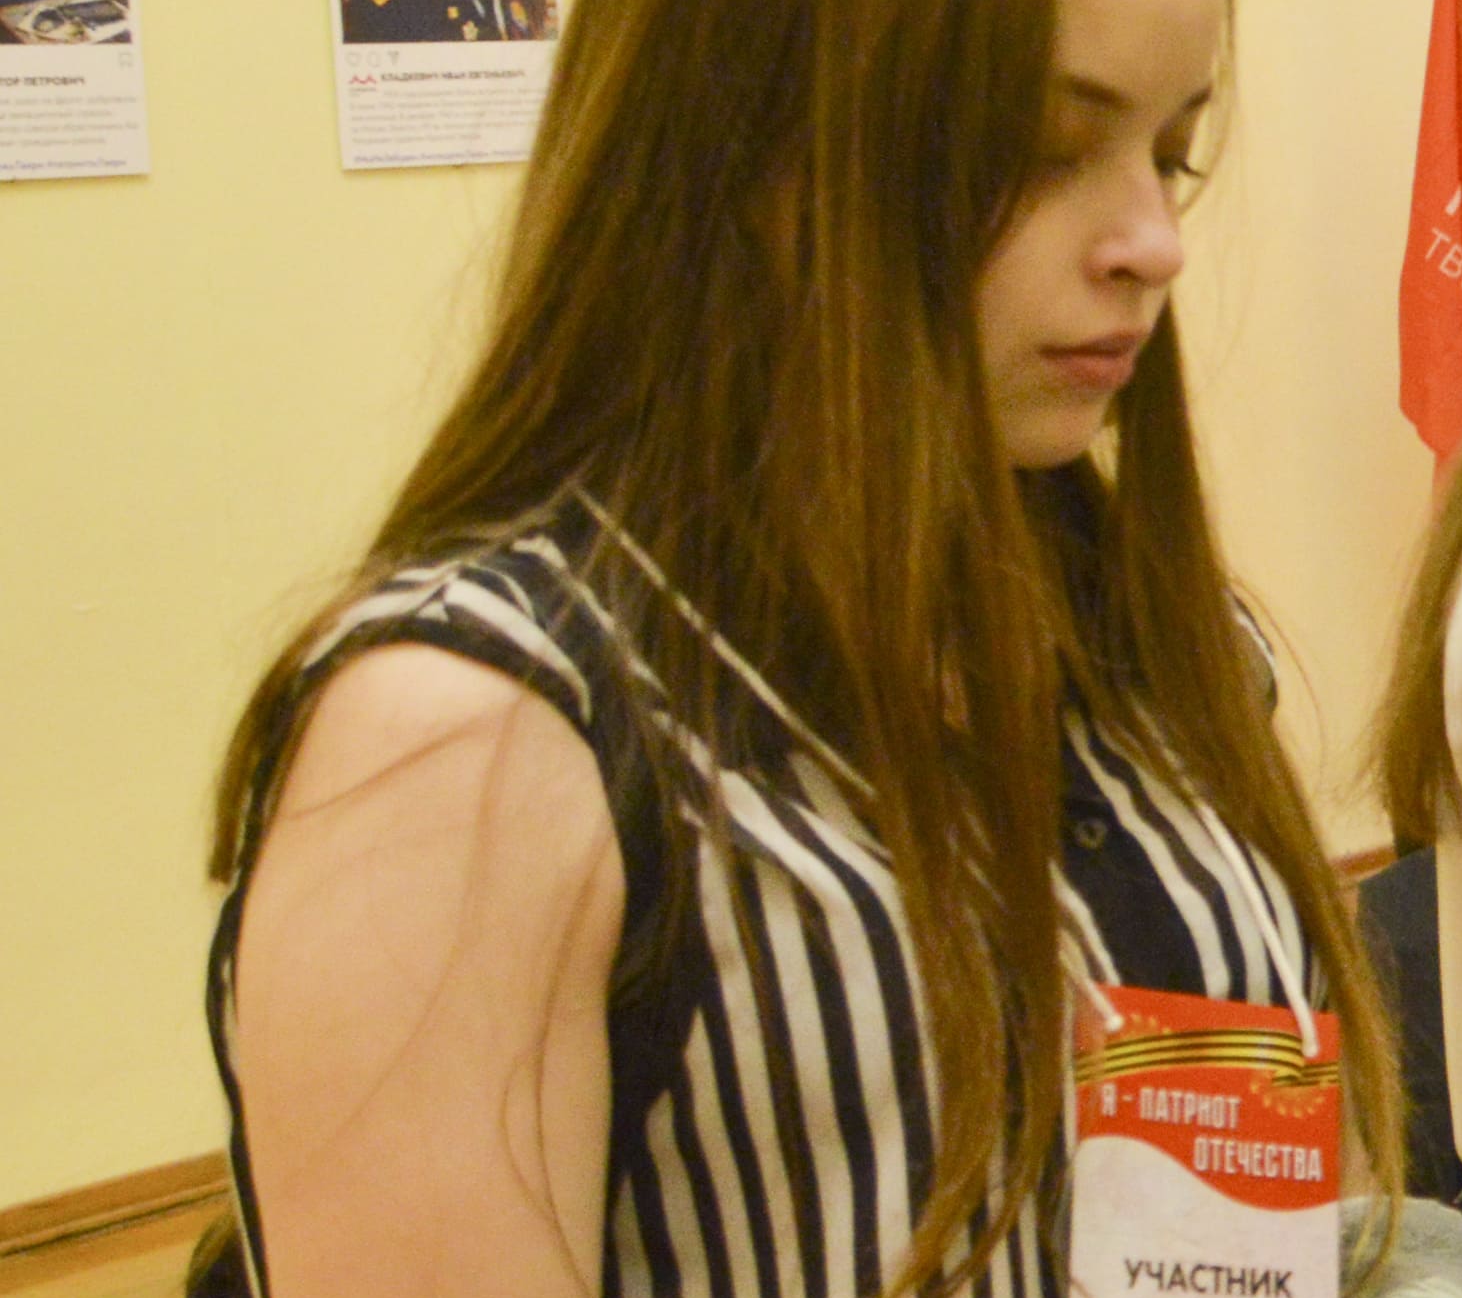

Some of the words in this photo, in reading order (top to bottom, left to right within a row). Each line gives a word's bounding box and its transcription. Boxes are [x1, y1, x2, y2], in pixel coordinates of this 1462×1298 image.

[1102, 1082, 1117, 1117] Я
[1140, 1087, 1241, 1129] ПАТРИОТ
[1194, 1136, 1324, 1182] ОТЕЧЕСТВА
